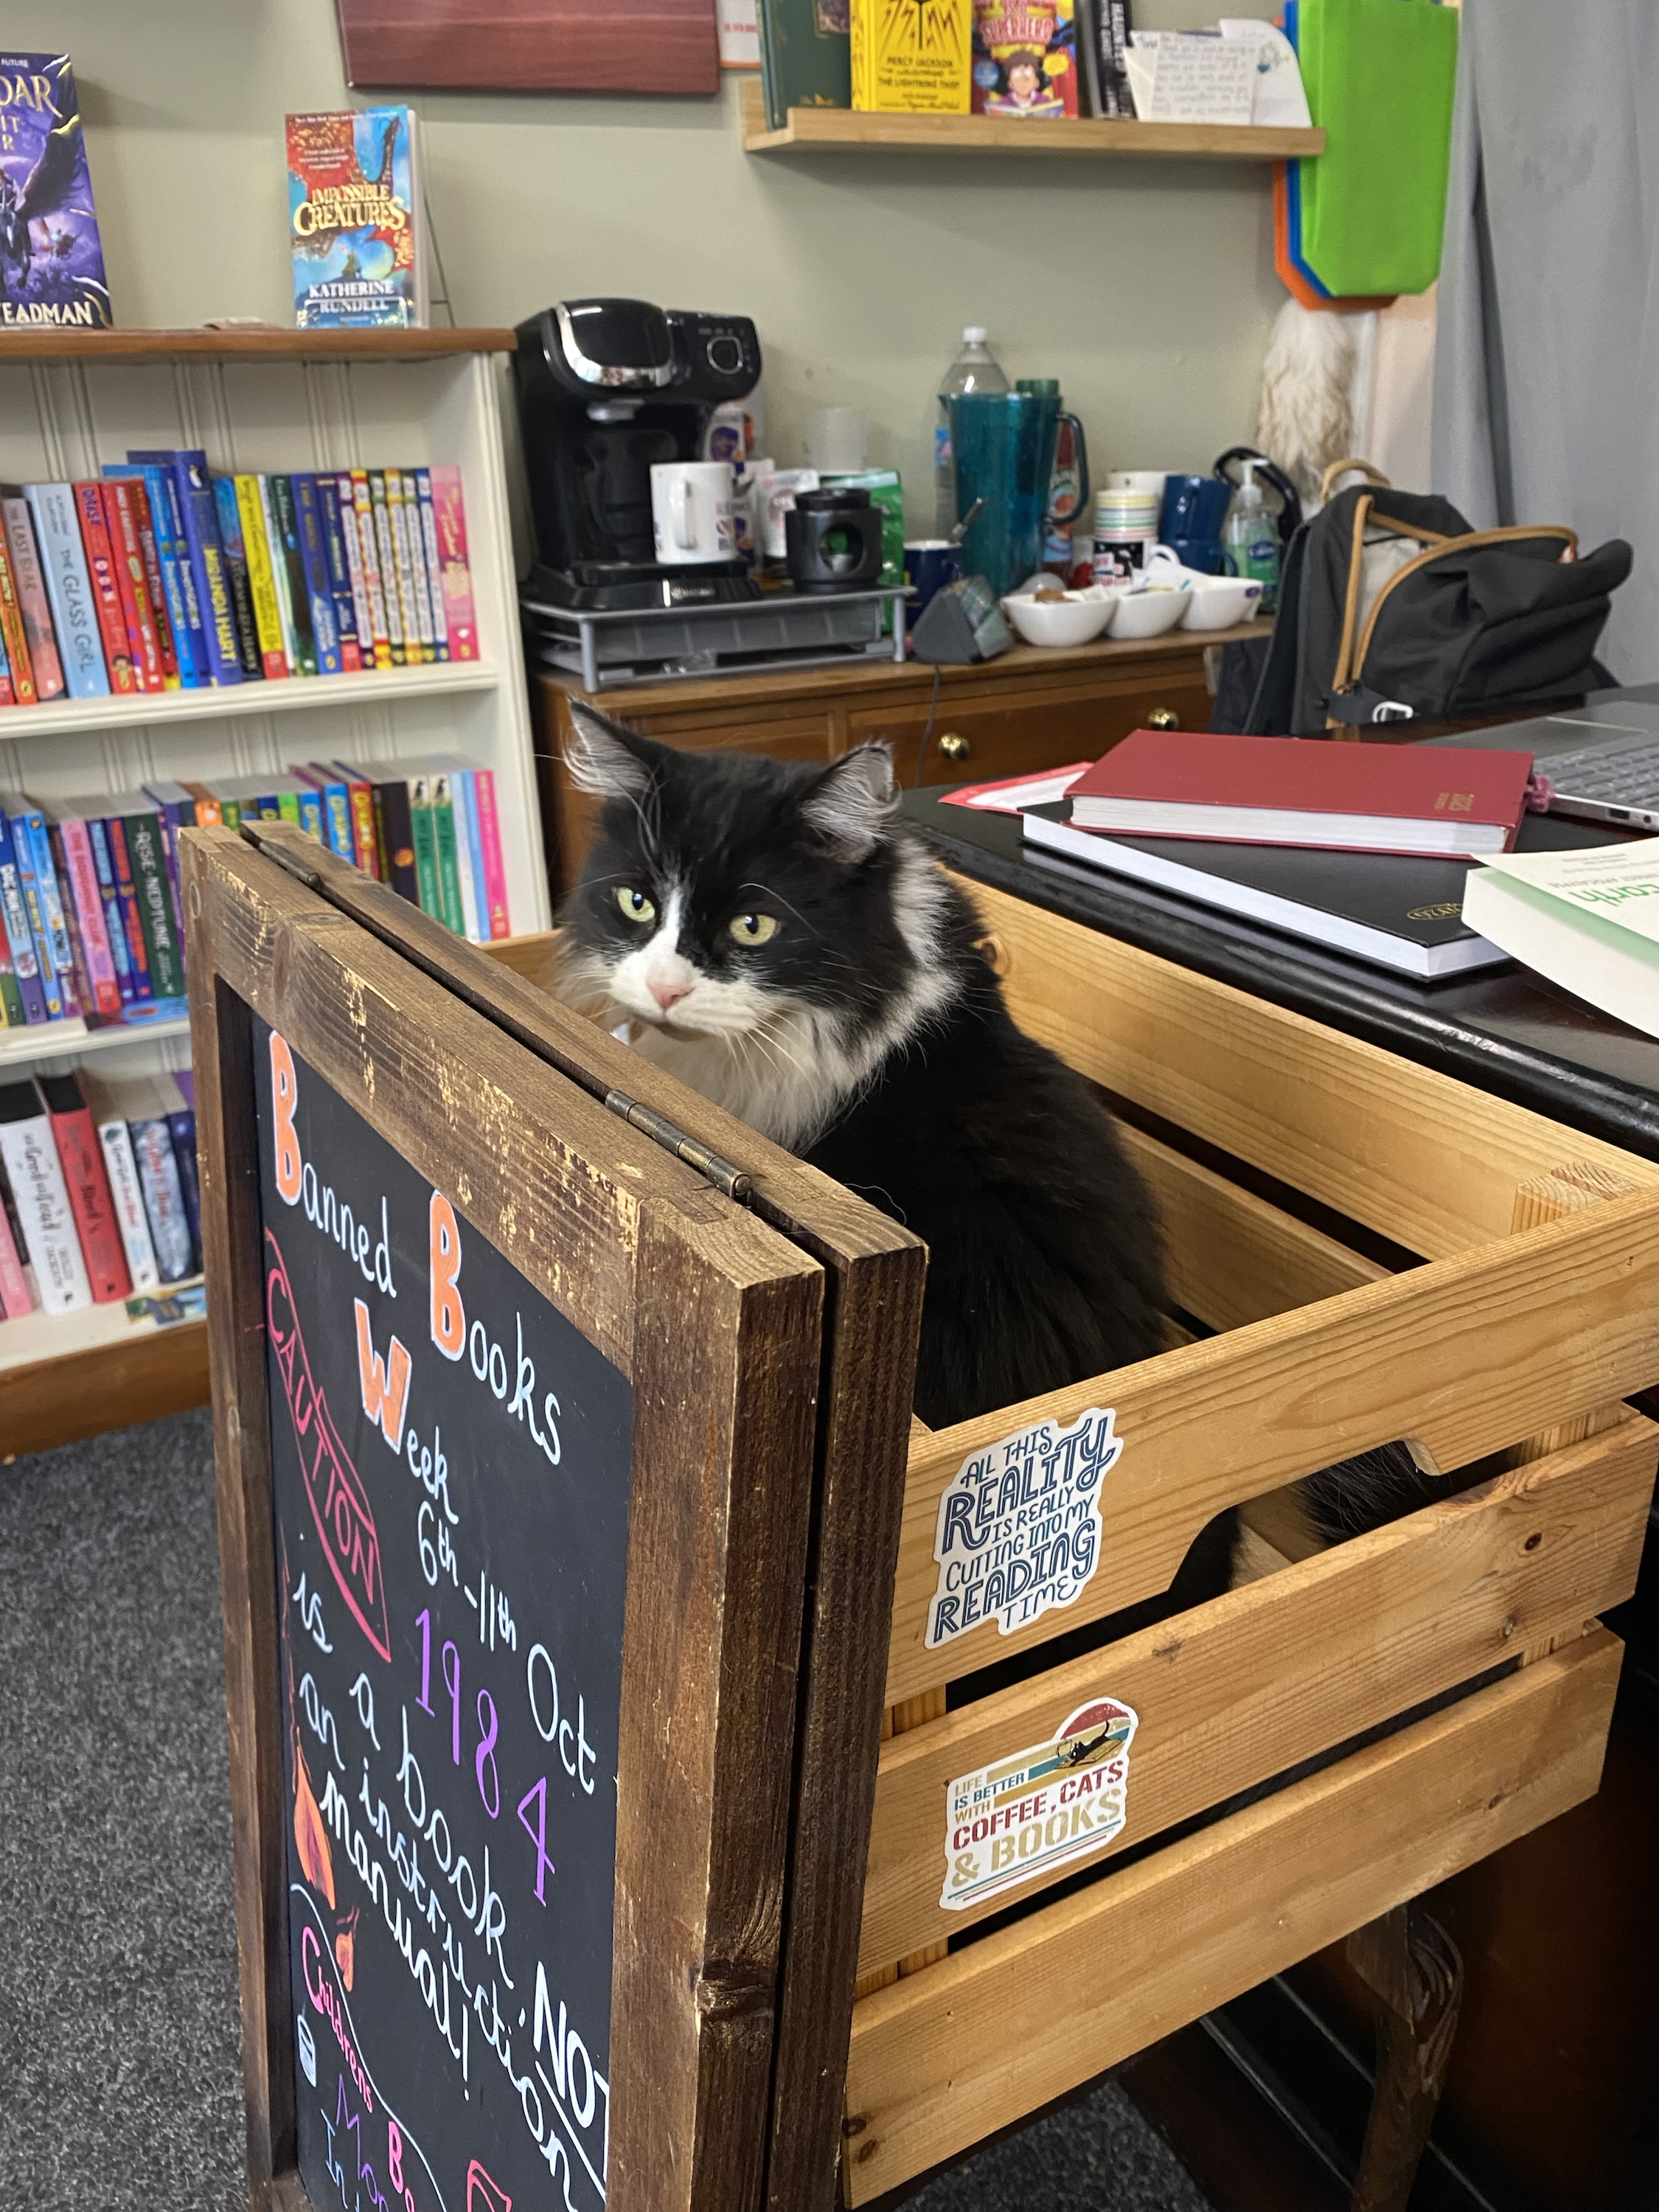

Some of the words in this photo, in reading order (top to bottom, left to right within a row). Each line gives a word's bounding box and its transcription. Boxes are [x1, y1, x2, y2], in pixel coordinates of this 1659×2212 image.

[293, 195, 406, 237] CREATURES
[311, 184, 390, 206] IMPOSSIBLE
[0, 301, 93, 325] EADMAN
[308, 279, 395, 298] KATHERINE
[59, 549, 72, 571] THE
[63, 574, 87, 629] GLASS
[215, 616, 237, 662] HART
[74, 633, 96, 675] GIRL
[269, 1029, 397, 1298] Banned
[429, 1189, 562, 1465] Books
[267, 1268, 374, 1605] CAUTION
[354, 1297, 459, 1524] Week
[942, 1416, 1116, 1555] REALITY
[960, 1454, 996, 1488] ALL
[1003, 1425, 1053, 1466] THIS
[946, 1533, 1024, 1593] CUTTING
[1026, 1513, 1063, 1550] INTO
[1064, 1493, 1095, 1529] MY
[992, 1517, 1012, 1544] IS
[1016, 1485, 1075, 1529] REALLY
[933, 1517, 1096, 1644] READING
[1003, 1575, 1078, 1629] TIME
[414, 1608, 557, 1907] 1984
[527, 1643, 597, 1795] Oct
[953, 1791, 1057, 1851] COFFEE,
[1060, 1759, 1124, 1804] CATS
[954, 1794, 968, 1811] IS
[973, 1772, 1025, 1802] BETTER
[955, 1774, 983, 1798] LIFE
[955, 1800, 991, 1825] WITH
[293, 1531, 333, 1653] is
[349, 1672, 381, 1751] a
[533, 1961, 611, 2184] NOT
[951, 1851, 981, 1888] &
[991, 1788, 1122, 1873] BOOKS
[299, 1672, 345, 1770] an
[359, 1758, 579, 2212] instruction
[319, 1771, 470, 2101] manual!
[302, 1925, 374, 2114] Childrens
